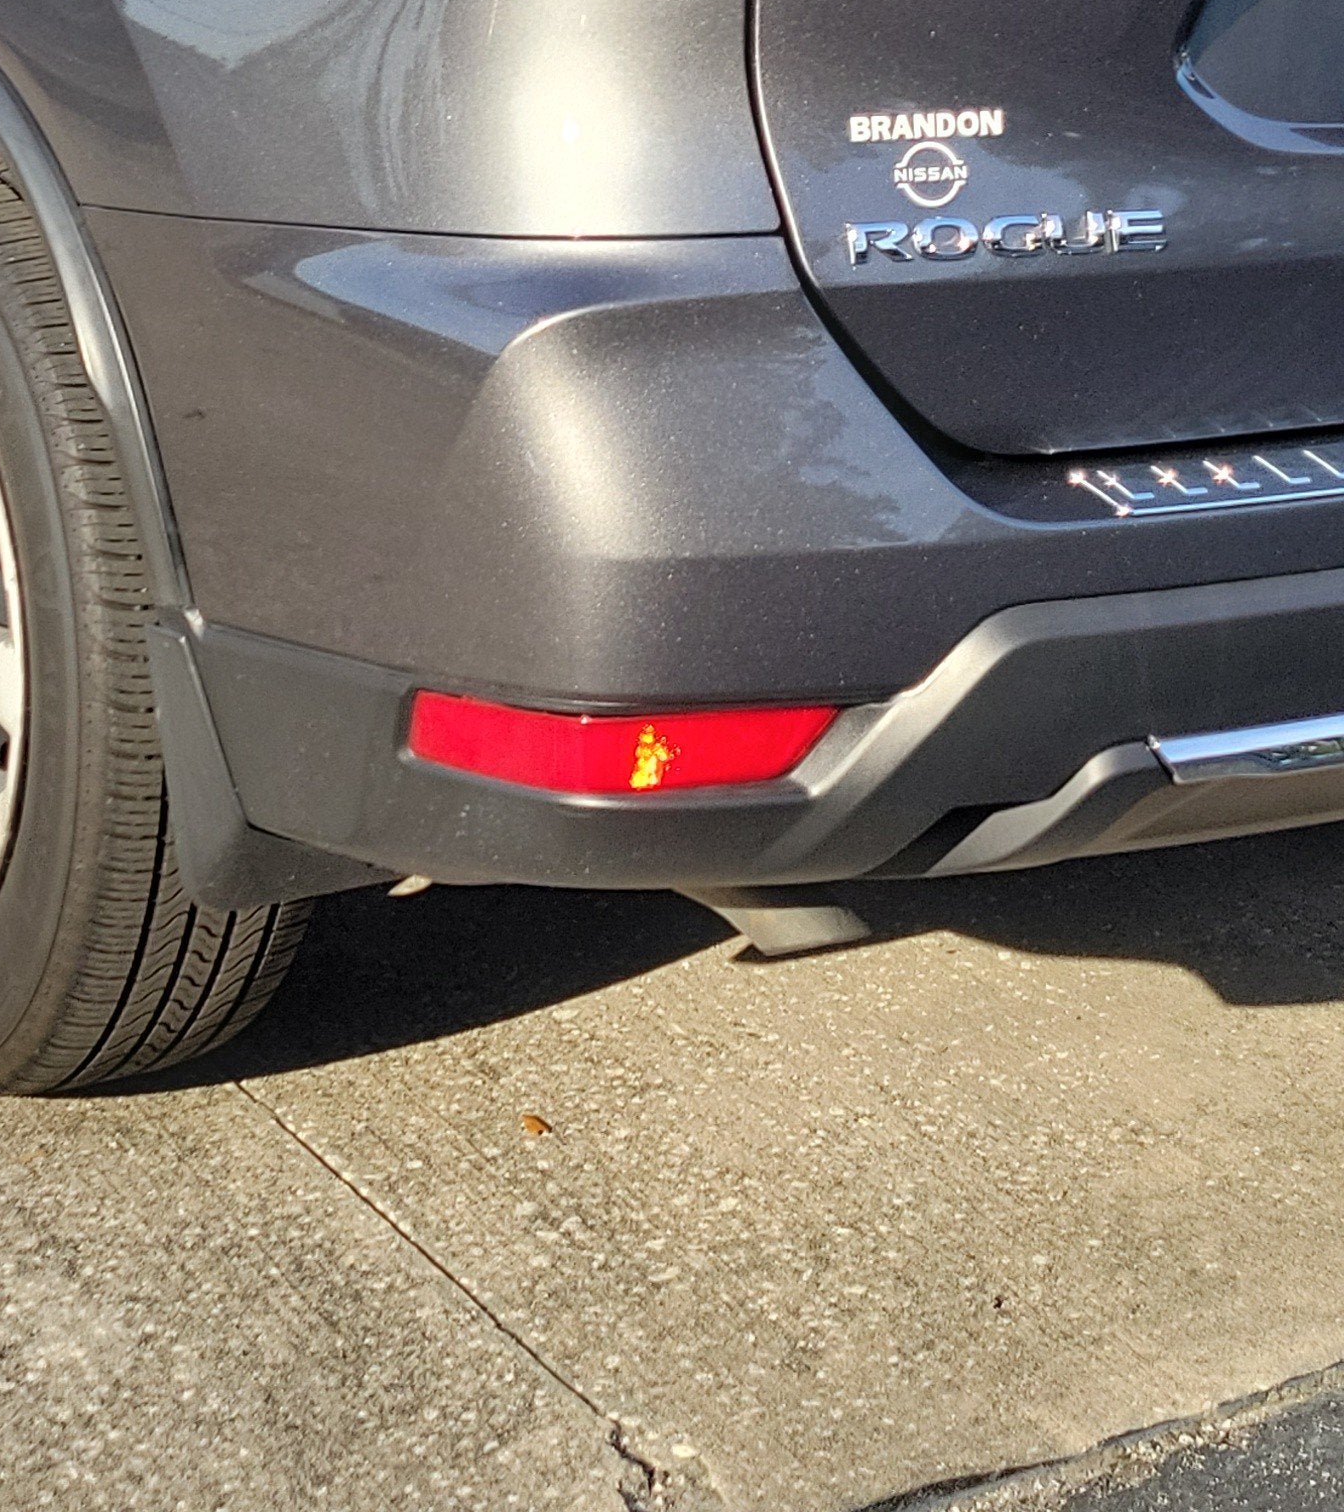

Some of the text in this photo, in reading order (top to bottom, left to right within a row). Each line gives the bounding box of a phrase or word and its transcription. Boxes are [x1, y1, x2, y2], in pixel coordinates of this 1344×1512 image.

[849, 110, 1003, 141] BRANDON
[894, 165, 968, 182] NISSAN
[846, 210, 1167, 265] ROGUE
